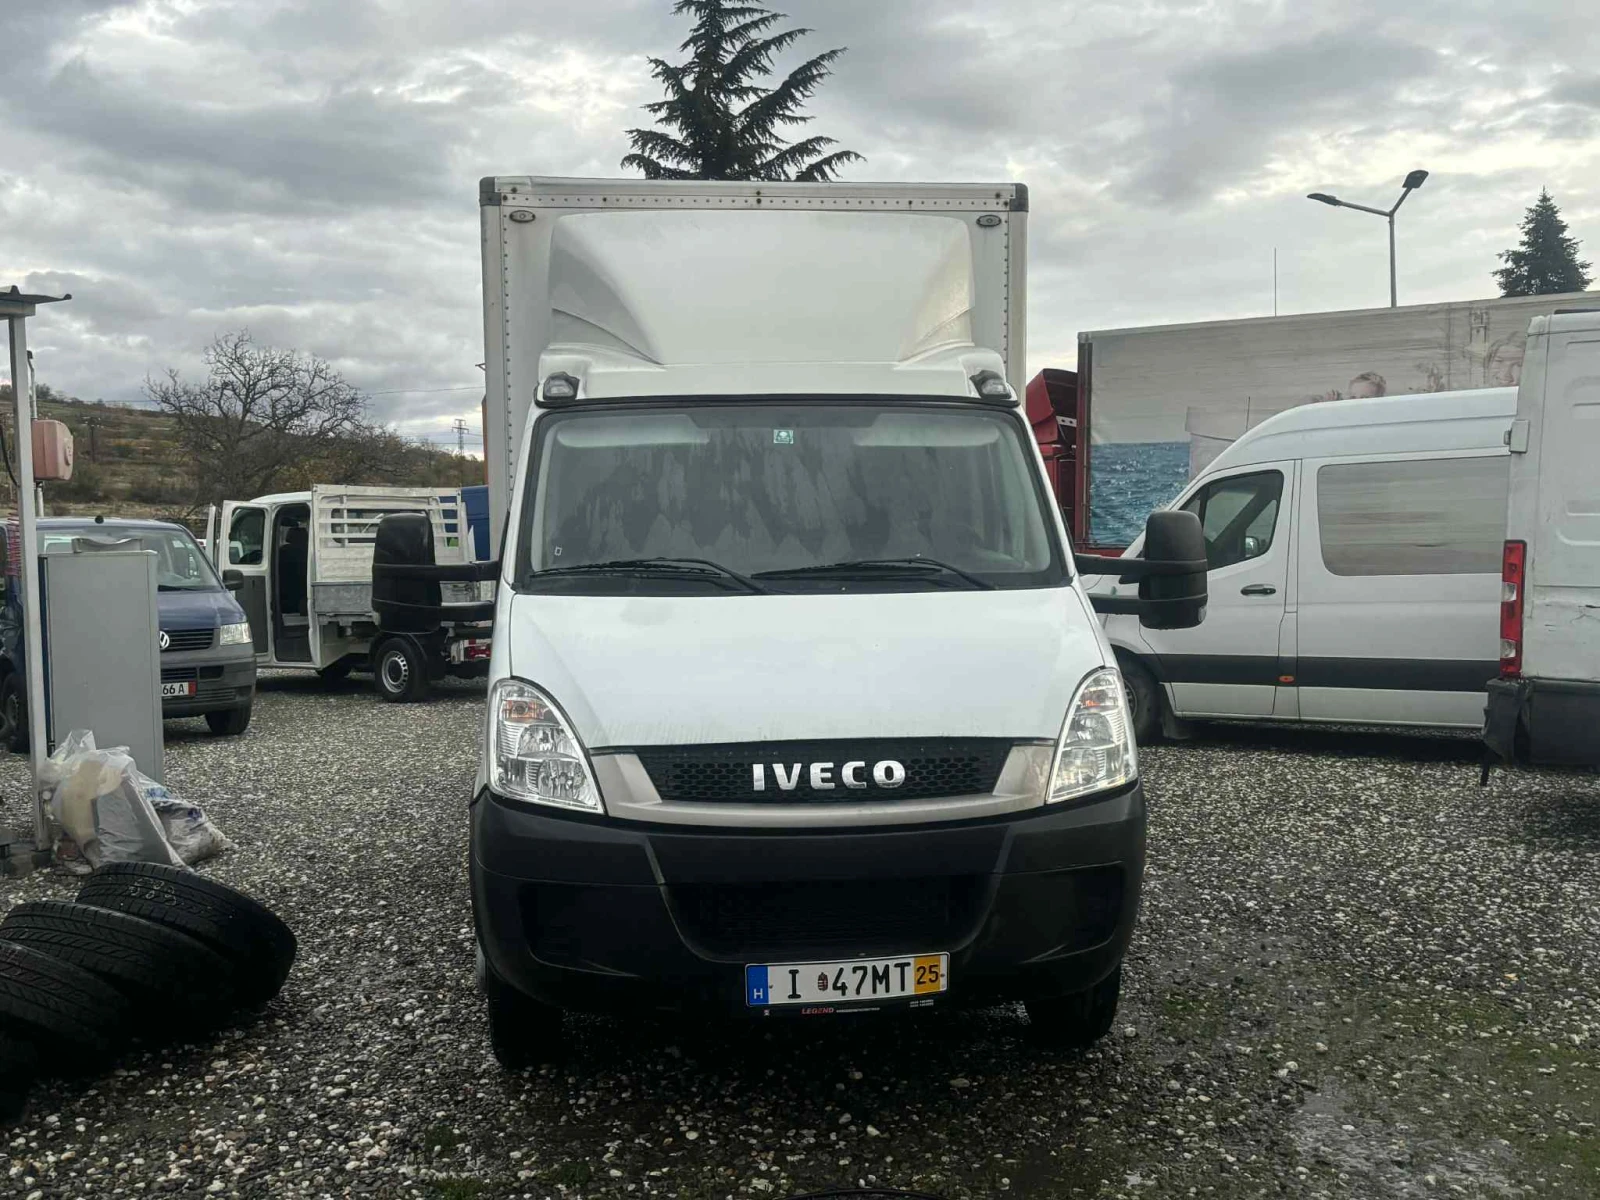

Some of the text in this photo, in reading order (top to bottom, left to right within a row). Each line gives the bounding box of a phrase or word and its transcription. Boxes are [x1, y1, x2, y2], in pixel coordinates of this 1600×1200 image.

[178, 683, 185, 694] A
[752, 760, 906, 791] IVECO
[753, 988, 764, 999] H
[832, 962, 911, 996] 47MT
[916, 964, 939, 985] 25
[801, 1007, 834, 1015] LEGEND
